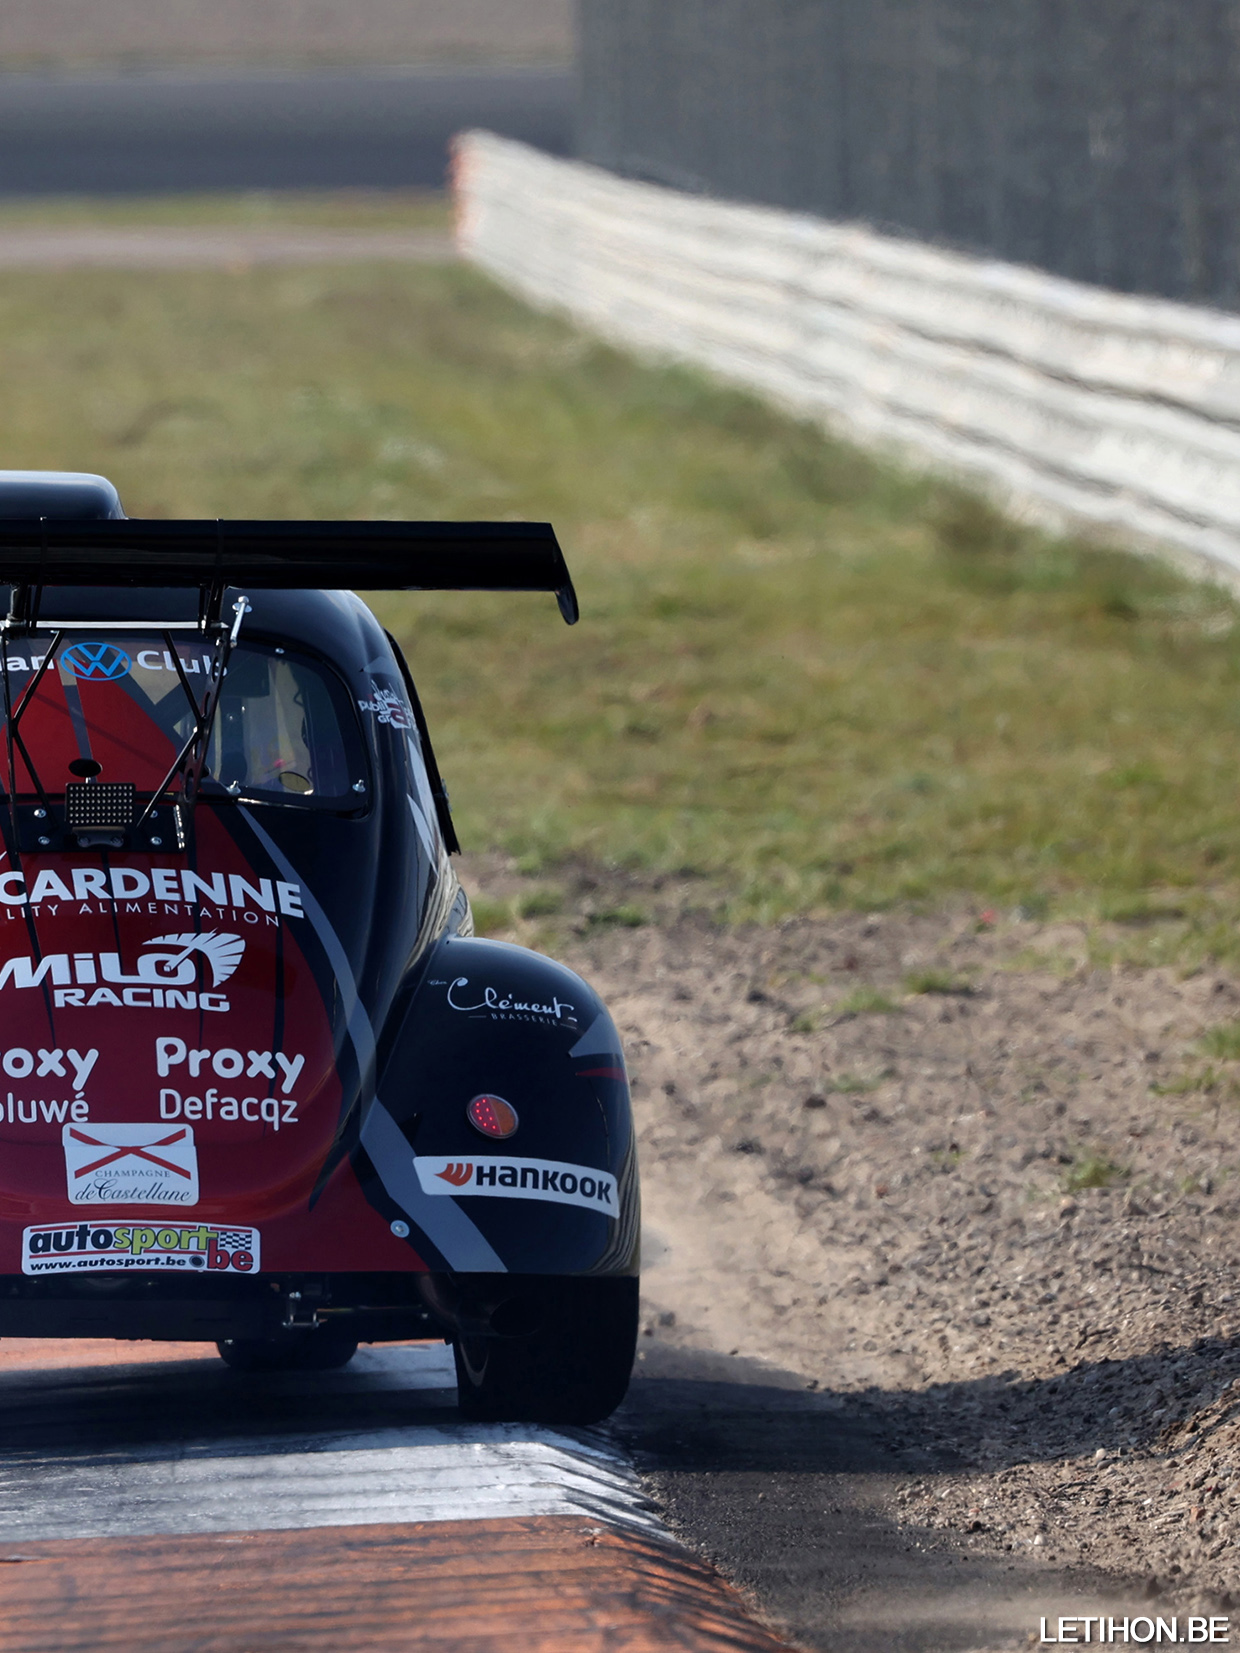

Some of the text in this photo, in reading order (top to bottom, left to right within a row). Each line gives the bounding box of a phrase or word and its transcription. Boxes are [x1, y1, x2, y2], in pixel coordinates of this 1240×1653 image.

[78, 901, 281, 928] ALIMENTATION
[53, 987, 231, 1013] RACING
[447, 976, 576, 1018] Clément
[490, 1013, 558, 1027] BRASSERIE
[155, 1036, 306, 1094] Proxy
[159, 1087, 299, 1132] Defacqz
[95, 1169, 172, 1179] CHAMPAGNE
[28, 1223, 219, 1256] autosport
[29, 1256, 187, 1272] www.autosport.be
